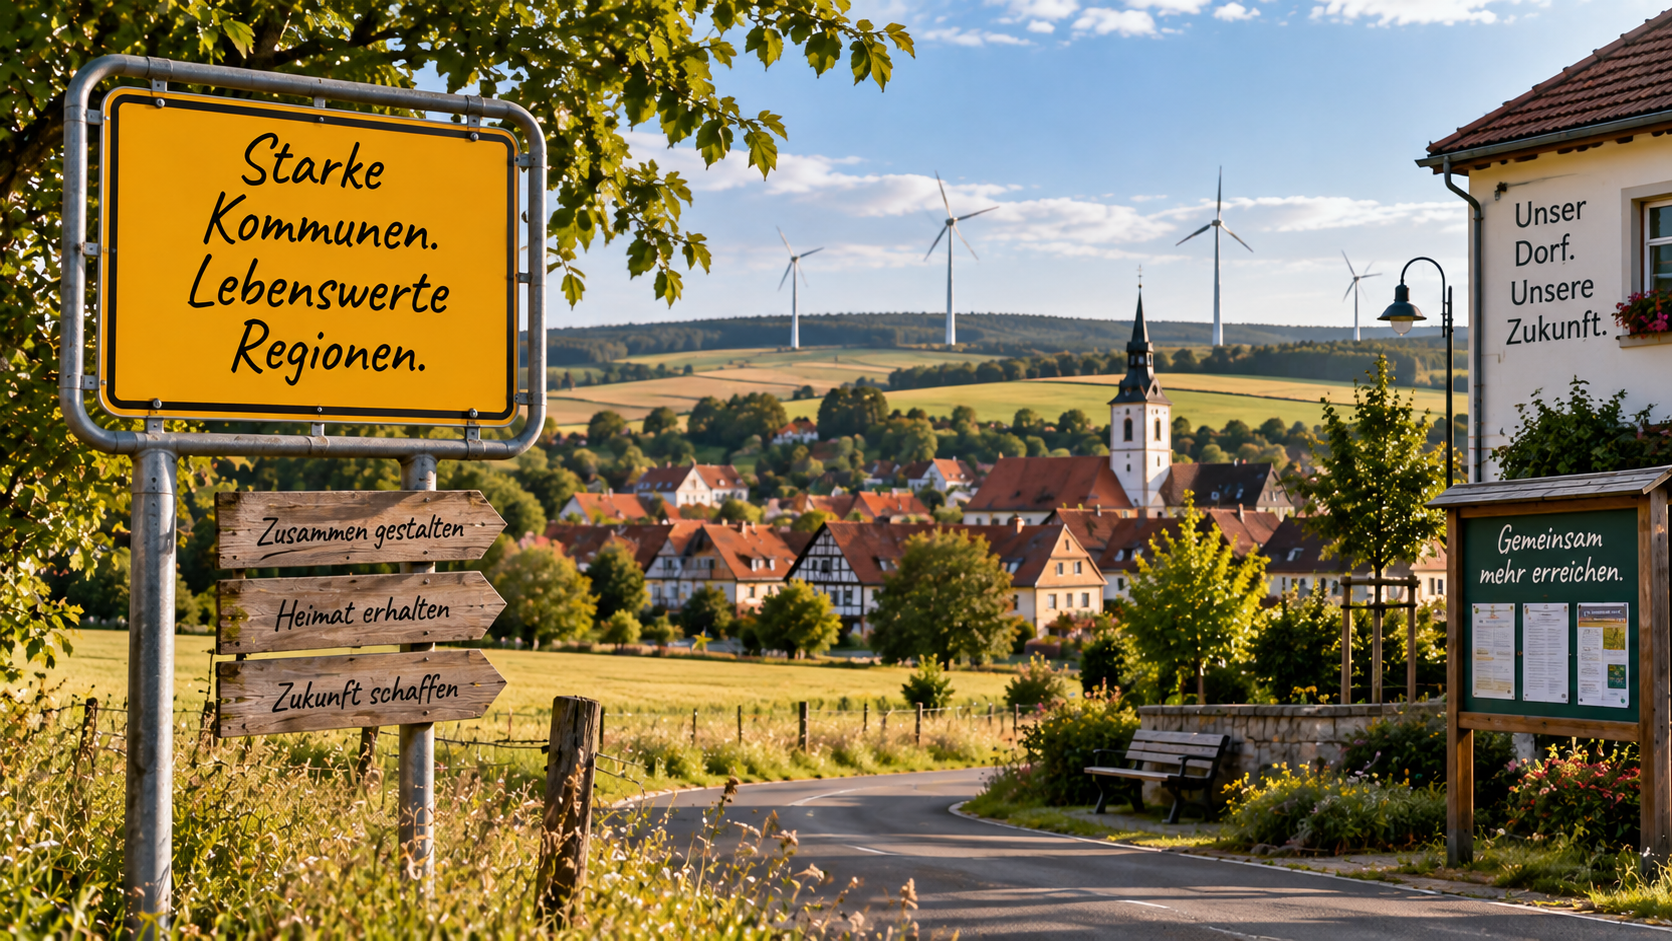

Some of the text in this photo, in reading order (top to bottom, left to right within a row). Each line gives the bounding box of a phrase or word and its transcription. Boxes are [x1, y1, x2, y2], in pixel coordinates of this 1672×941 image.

[241, 132, 385, 190] Starke
[203, 190, 438, 250] Kommunen.
[1515, 200, 1587, 228] Unser
[1515, 233, 1575, 267] Dorf.
[187, 253, 450, 313] Lebenswerte
[1511, 278, 1594, 306] Unsere
[1505, 309, 1608, 345] Zukunft.
[231, 318, 426, 386] Regionen.
[256, 514, 464, 549] Zusammen gestalten
[1498, 524, 1603, 554] Gemeinsam
[1479, 556, 1624, 584] mehr erreichen.
[274, 595, 450, 632] Heimat erhalten
[271, 673, 459, 713] Zukunft schaffen
